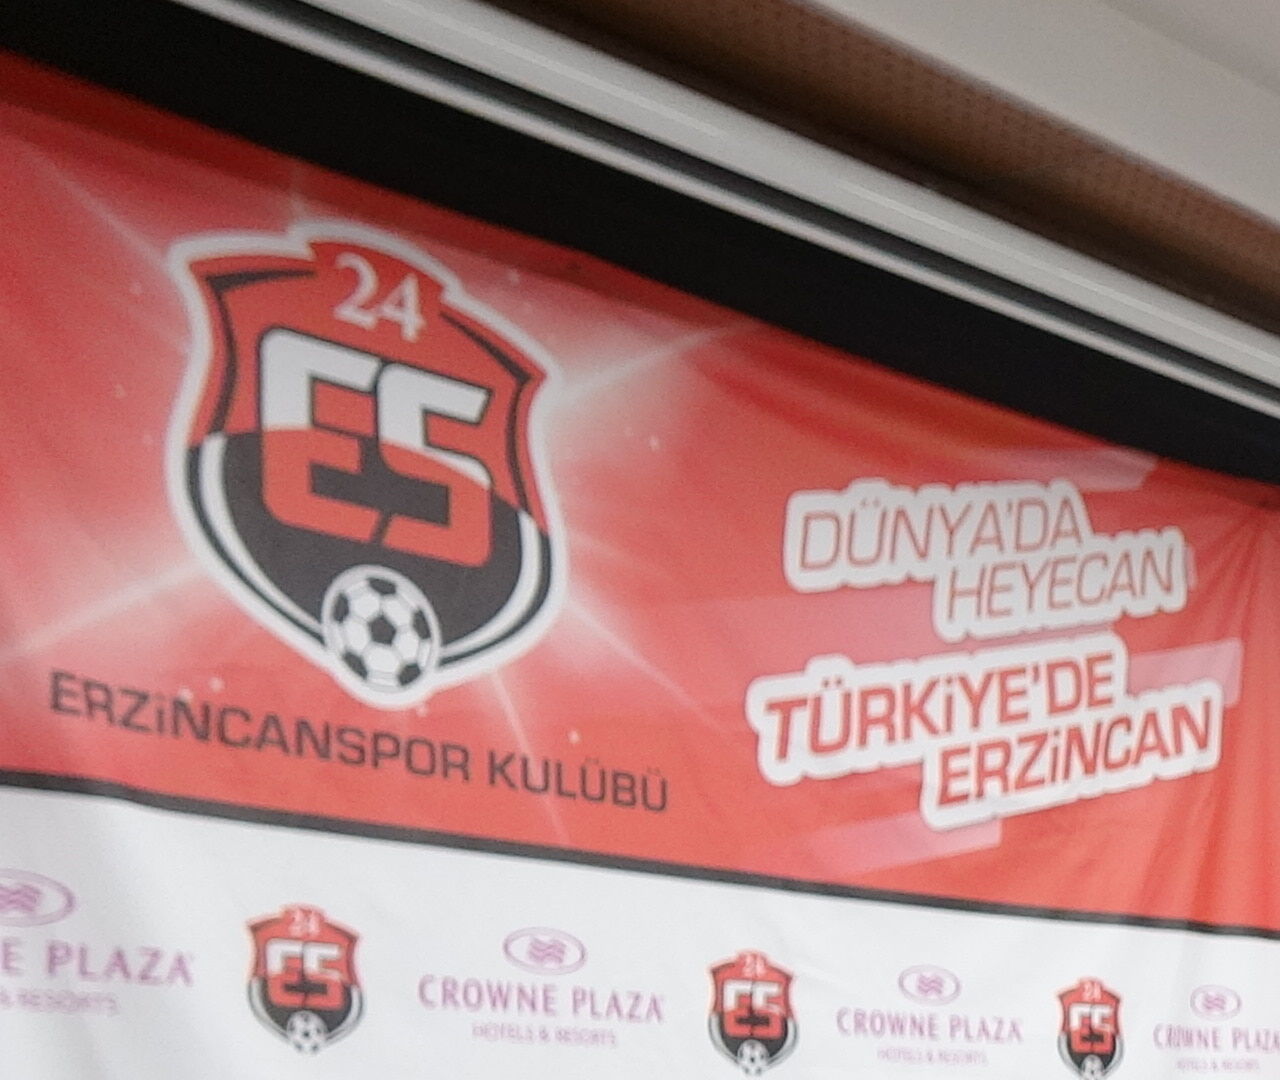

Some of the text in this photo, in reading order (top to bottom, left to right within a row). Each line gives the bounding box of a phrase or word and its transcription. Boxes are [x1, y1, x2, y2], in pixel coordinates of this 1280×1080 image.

[333, 253, 426, 343] 24
[259, 325, 494, 569] ES
[799, 494, 1085, 574] DÜNYA'DA
[946, 544, 1176, 622] HEYECAN
[488, 747, 669, 813] KULÜBÜ
[46, 939, 193, 988] PLAZA
[266, 937, 345, 1009] ES
[418, 973, 664, 1024] CROWNE PLAZA
[836, 1006, 1025, 1045] CROWNE PLAZA
[1152, 1022, 1220, 1052] CROWNE
